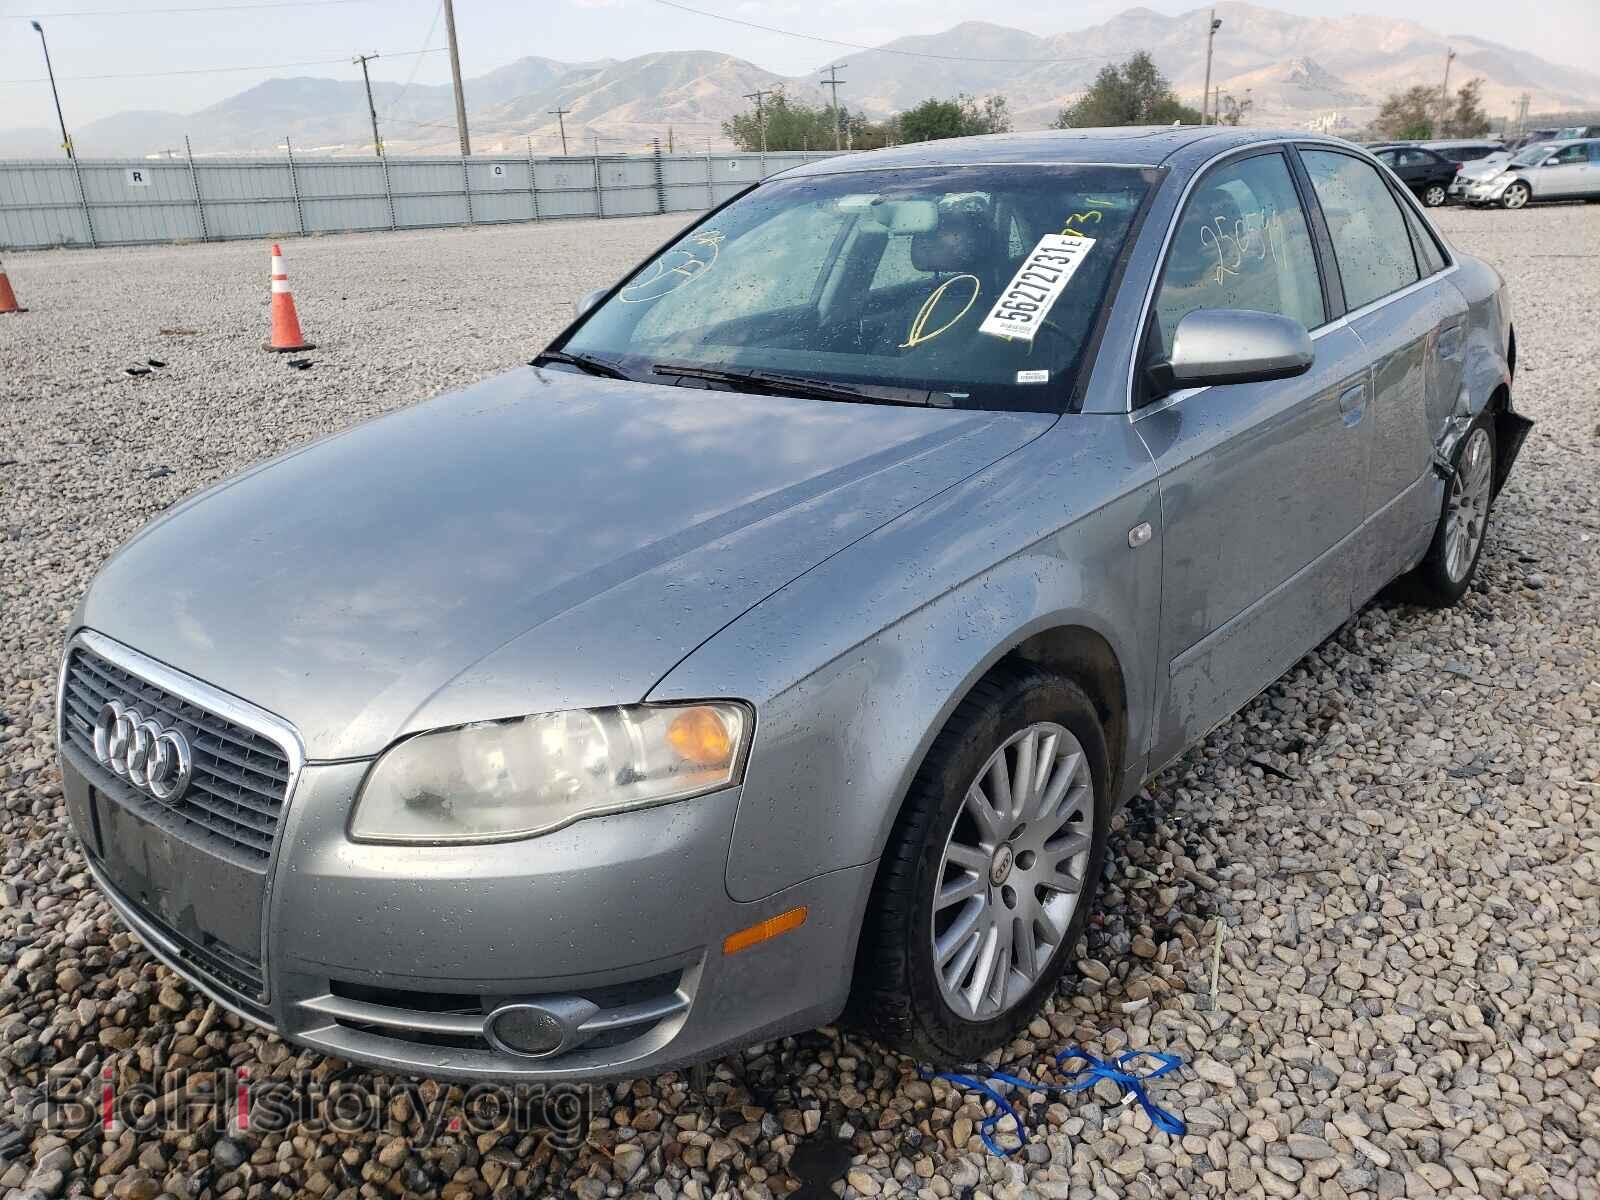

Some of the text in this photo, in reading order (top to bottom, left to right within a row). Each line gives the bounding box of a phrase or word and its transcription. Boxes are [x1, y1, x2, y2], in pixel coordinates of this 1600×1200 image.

[495, 166, 503, 175] Q
[132, 171, 143, 182] R
[994, 247, 1077, 323] 56272731
[1061, 239, 1082, 247] E
